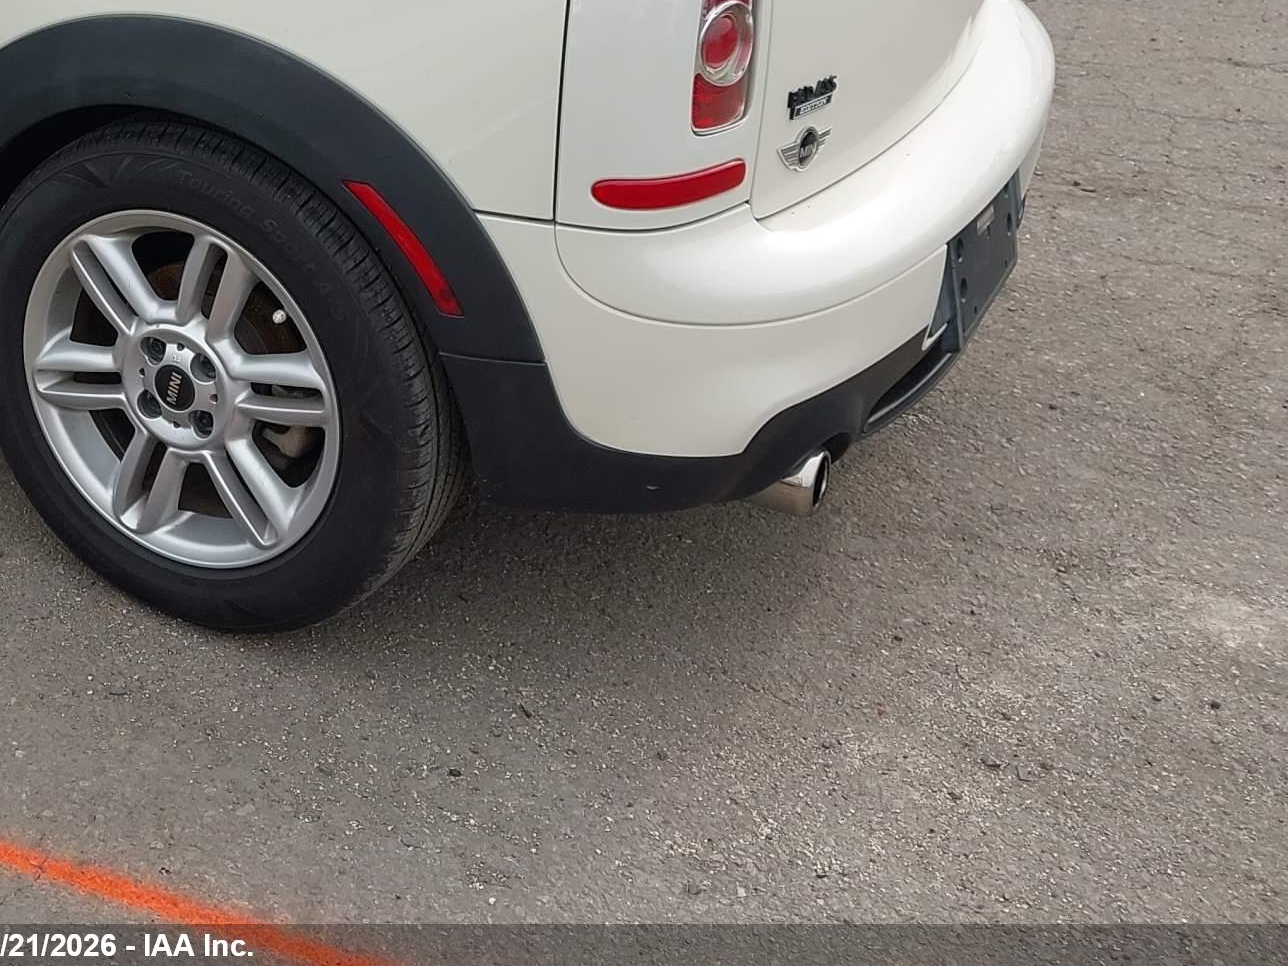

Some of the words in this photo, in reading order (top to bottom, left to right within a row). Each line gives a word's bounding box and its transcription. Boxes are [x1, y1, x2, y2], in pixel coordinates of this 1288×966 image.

[179, 169, 257, 220] Touring
[261, 218, 317, 273] Sport
[166, 371, 183, 406] MINI
